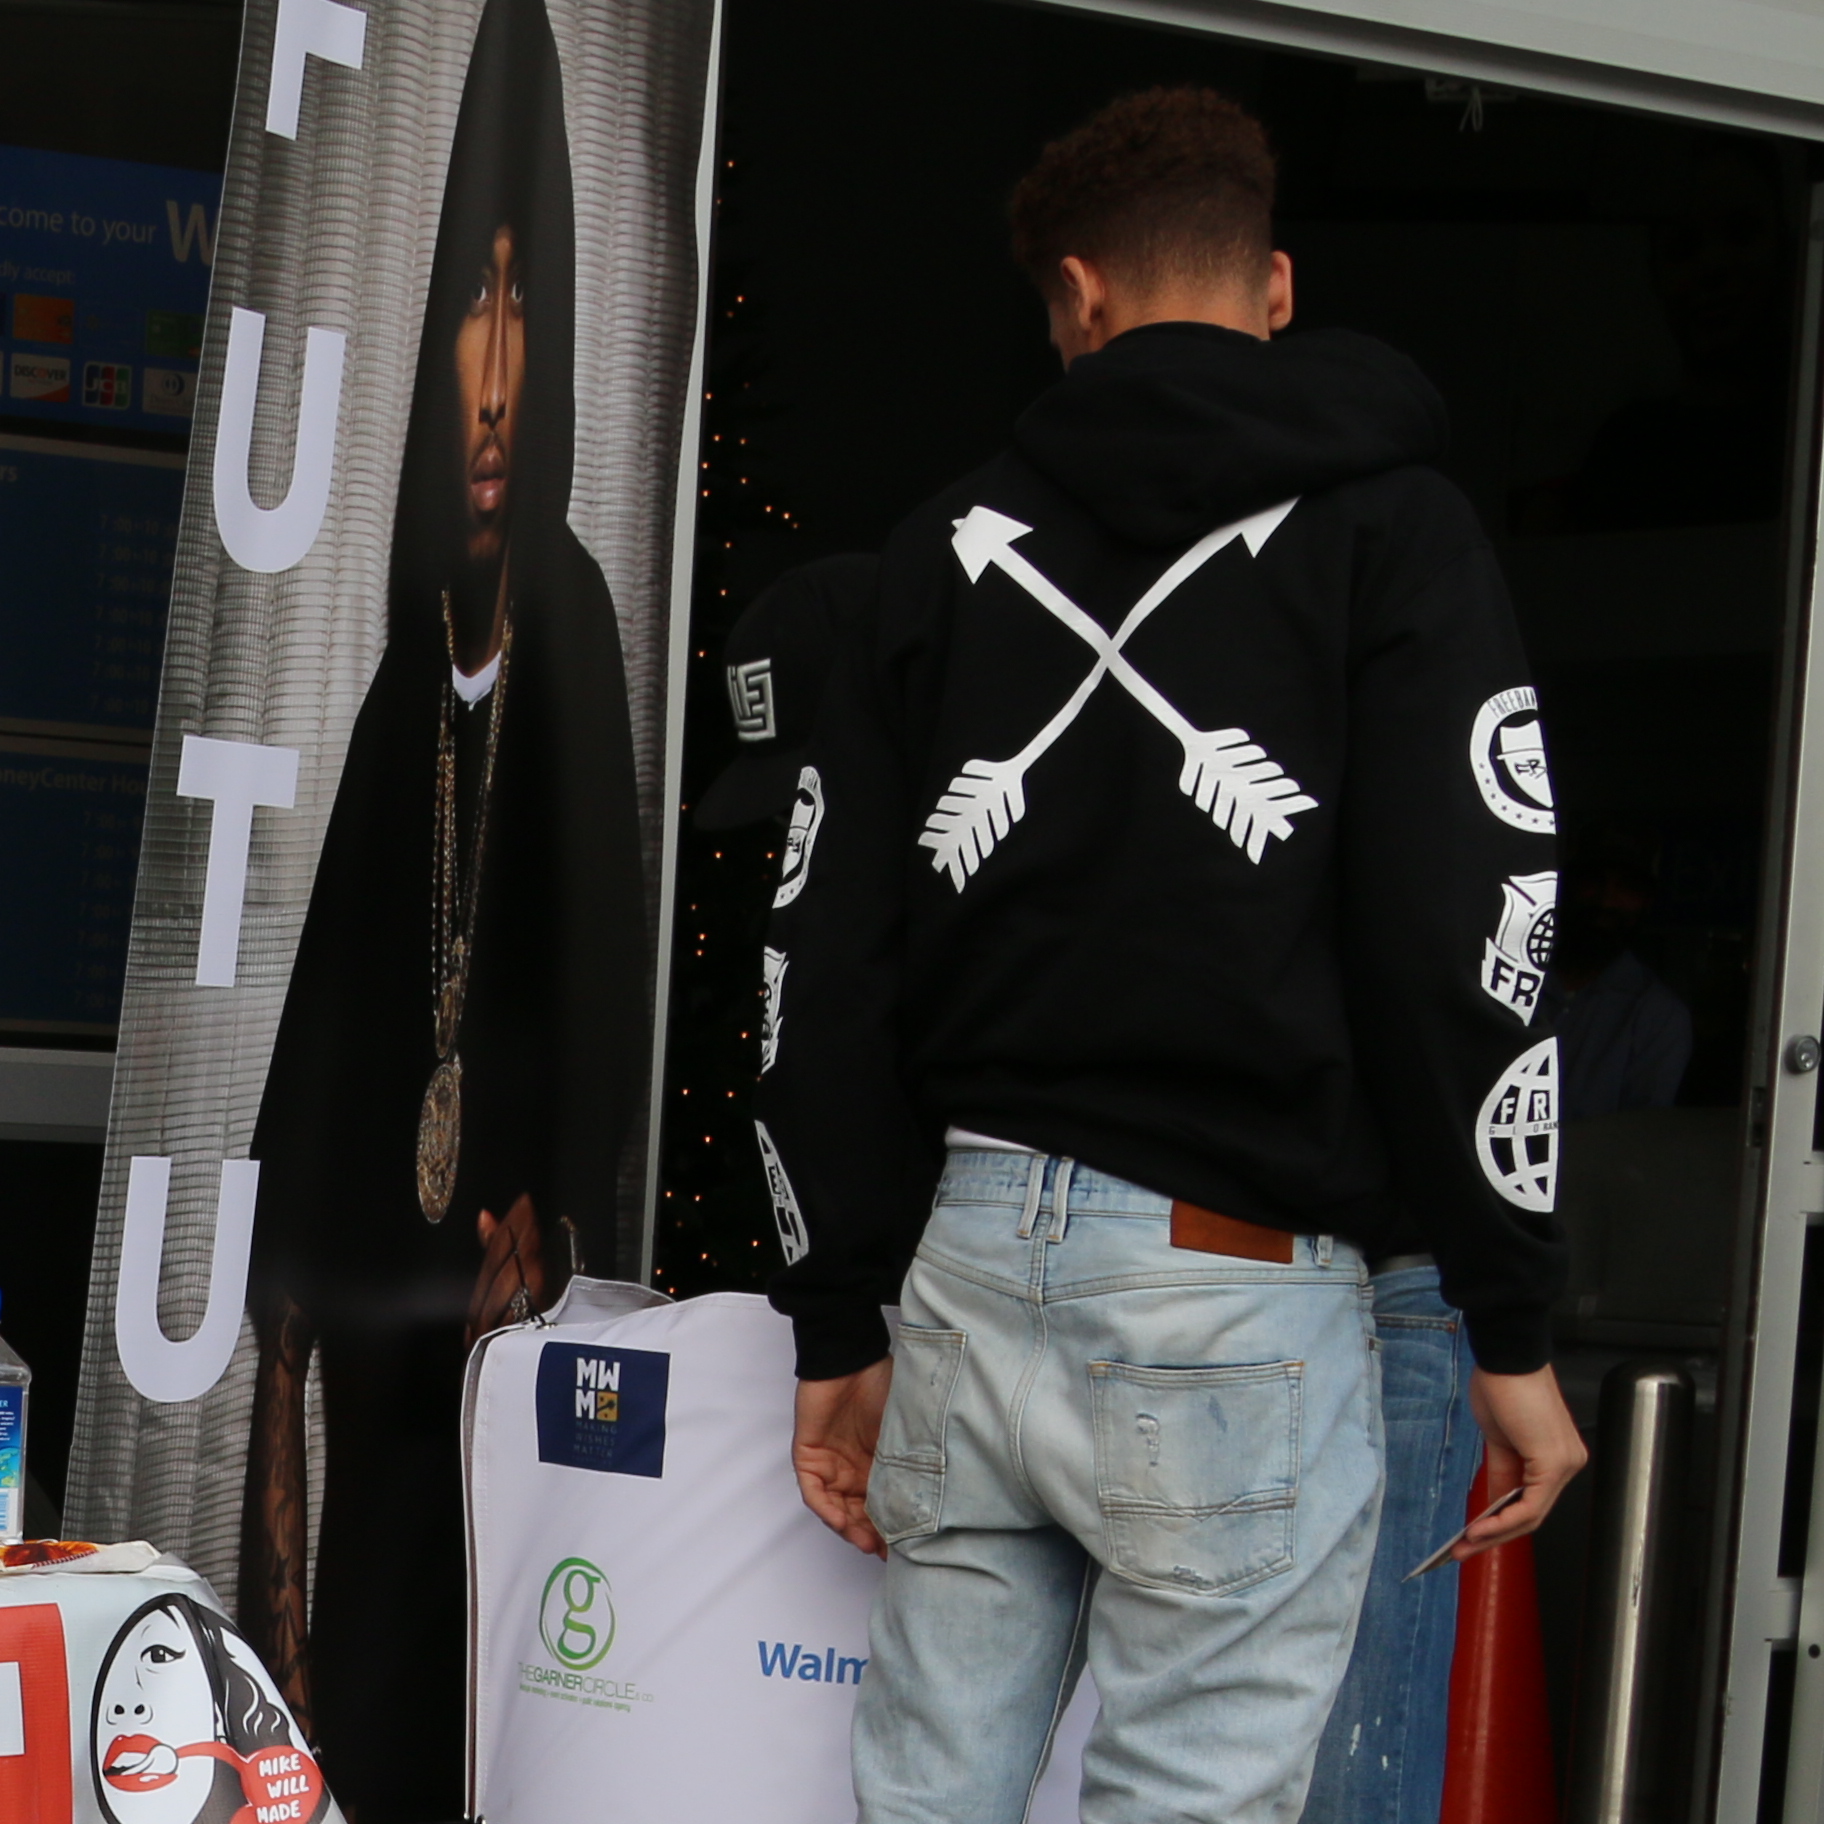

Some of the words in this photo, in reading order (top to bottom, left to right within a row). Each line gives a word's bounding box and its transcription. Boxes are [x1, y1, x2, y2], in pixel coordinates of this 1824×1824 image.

[71, 212, 96, 236] to
[102, 216, 158, 246] your
[576, 1357, 621, 1392] MW
[258, 1753, 301, 1777] MIKE
[266, 1774, 310, 1799] WILL
[256, 1800, 301, 1823] MADE
